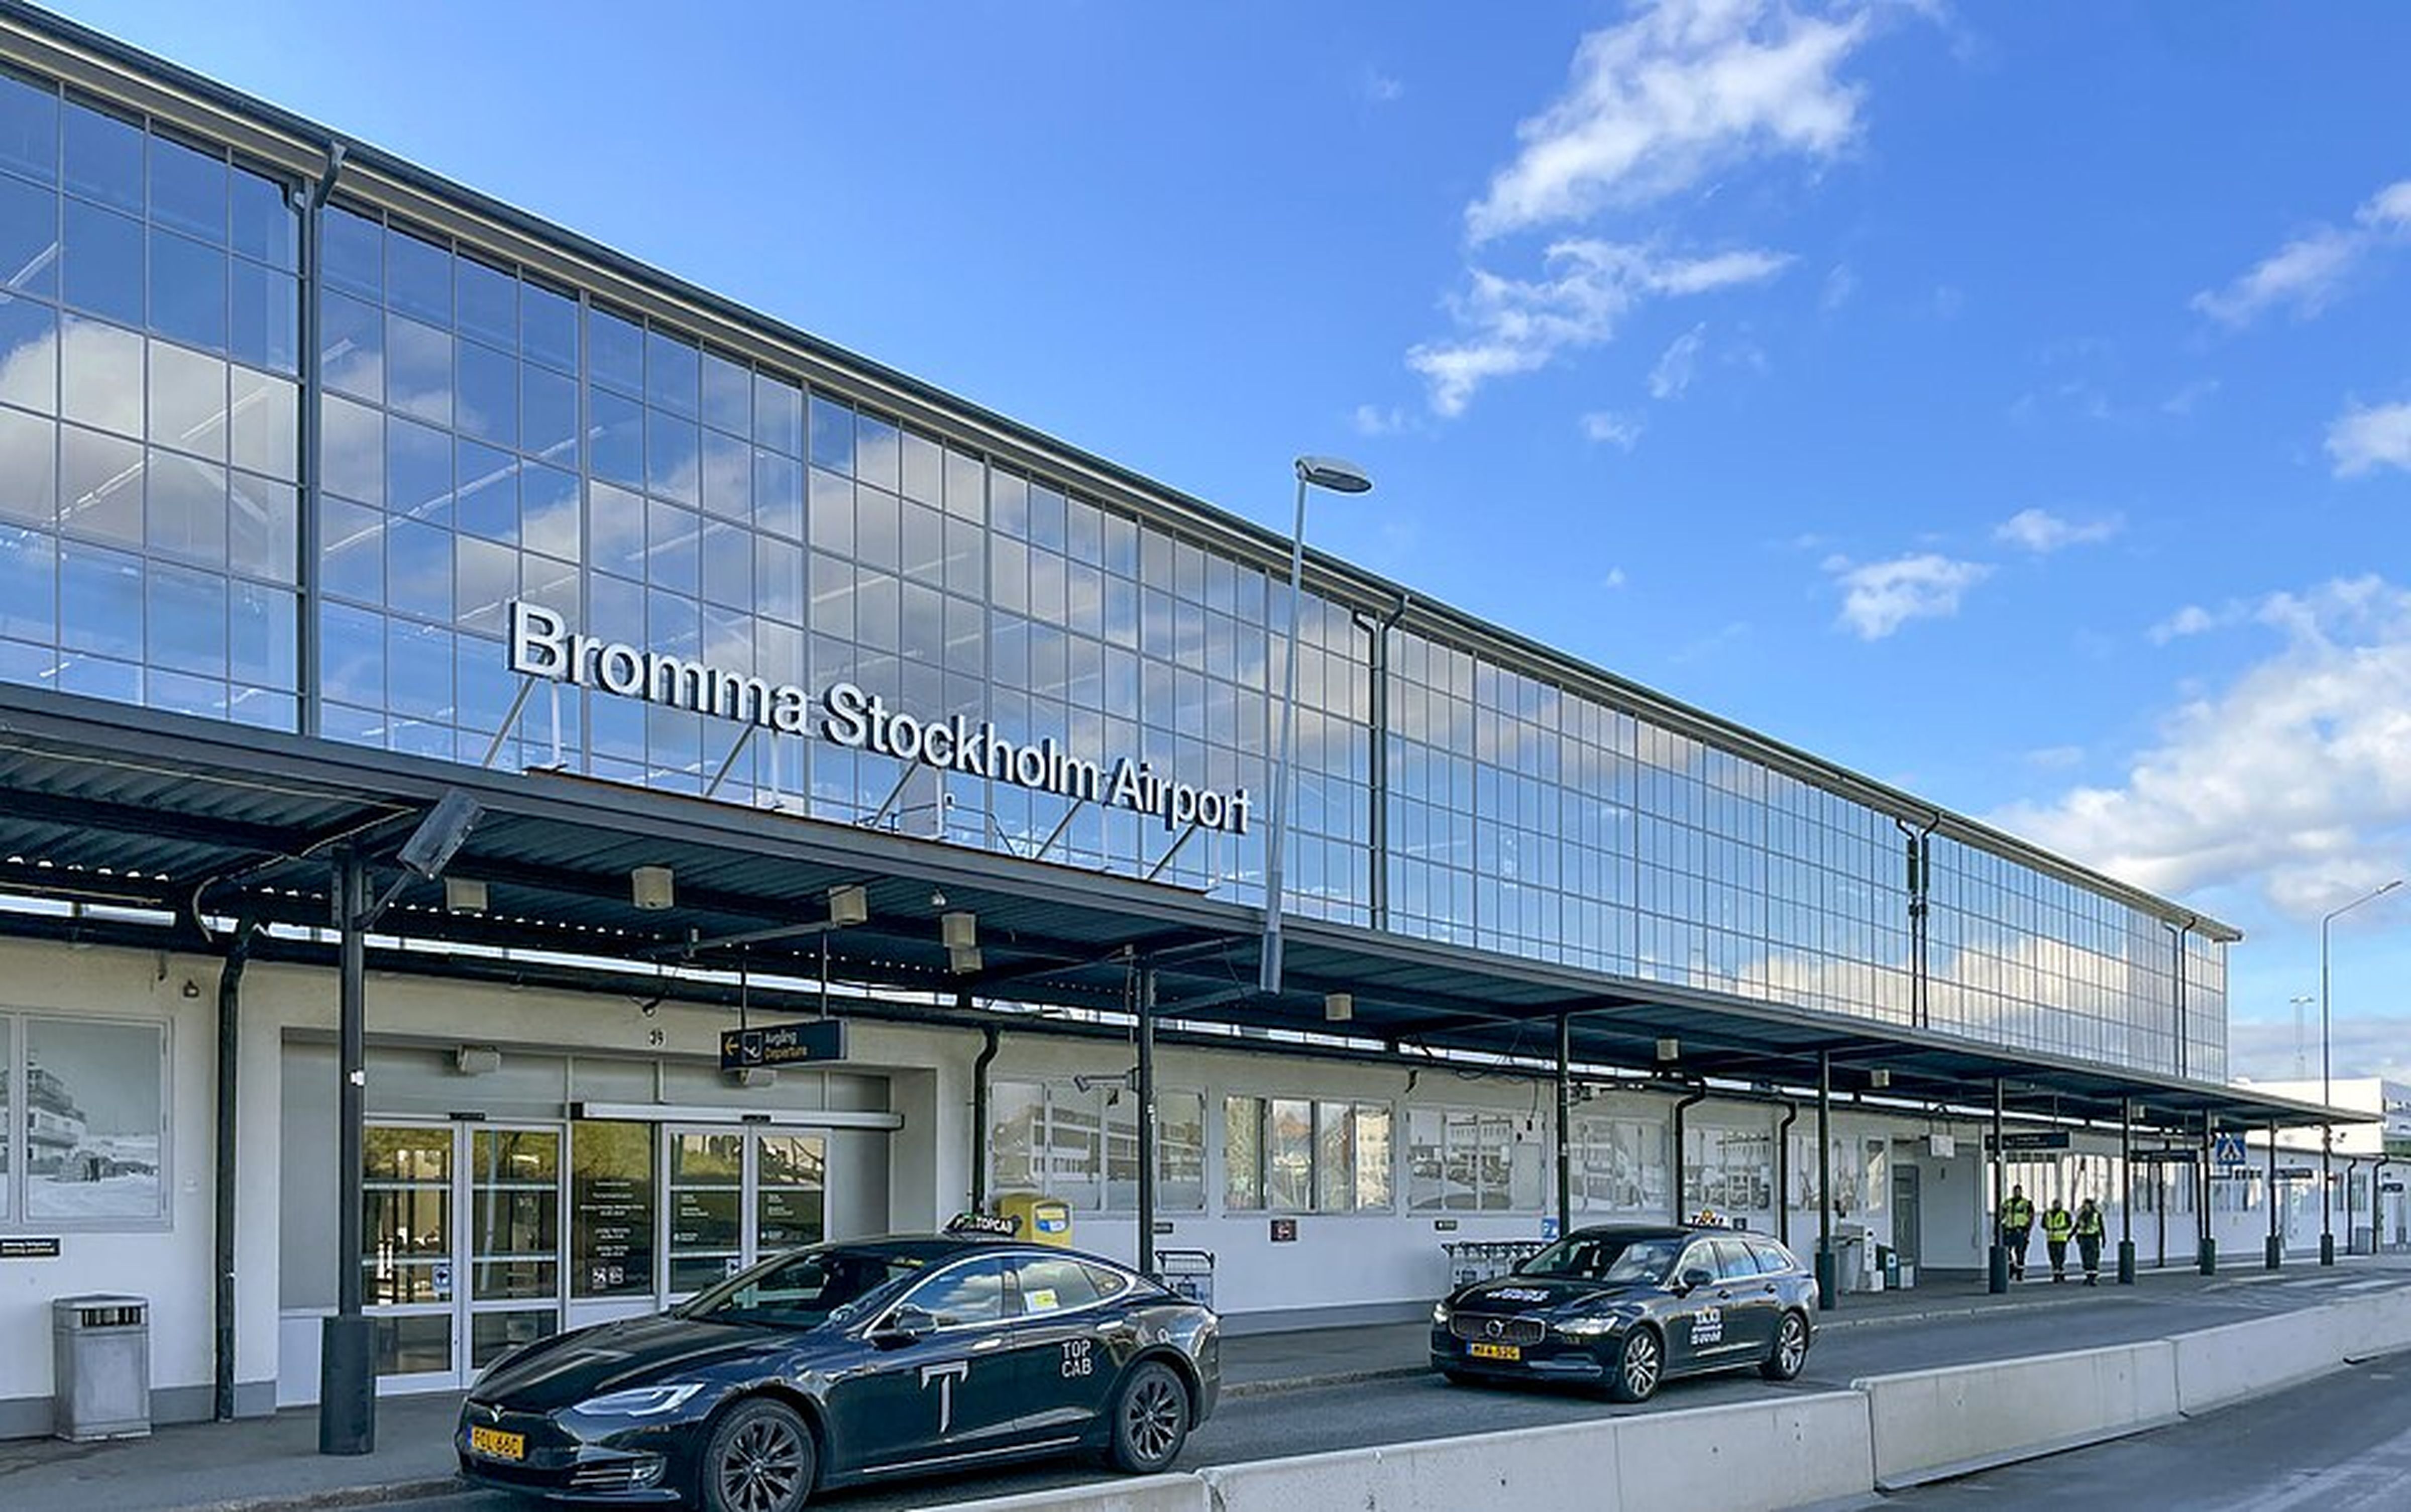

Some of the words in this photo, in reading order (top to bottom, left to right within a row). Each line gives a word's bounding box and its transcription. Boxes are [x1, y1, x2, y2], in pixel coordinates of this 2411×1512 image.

[509, 601, 811, 735] Bromma
[823, 682, 1099, 800] Stockholm
[1109, 757, 1252, 833] Airport
[1061, 1339, 1091, 1359] TOP
[1061, 1358, 1092, 1378] CAB
